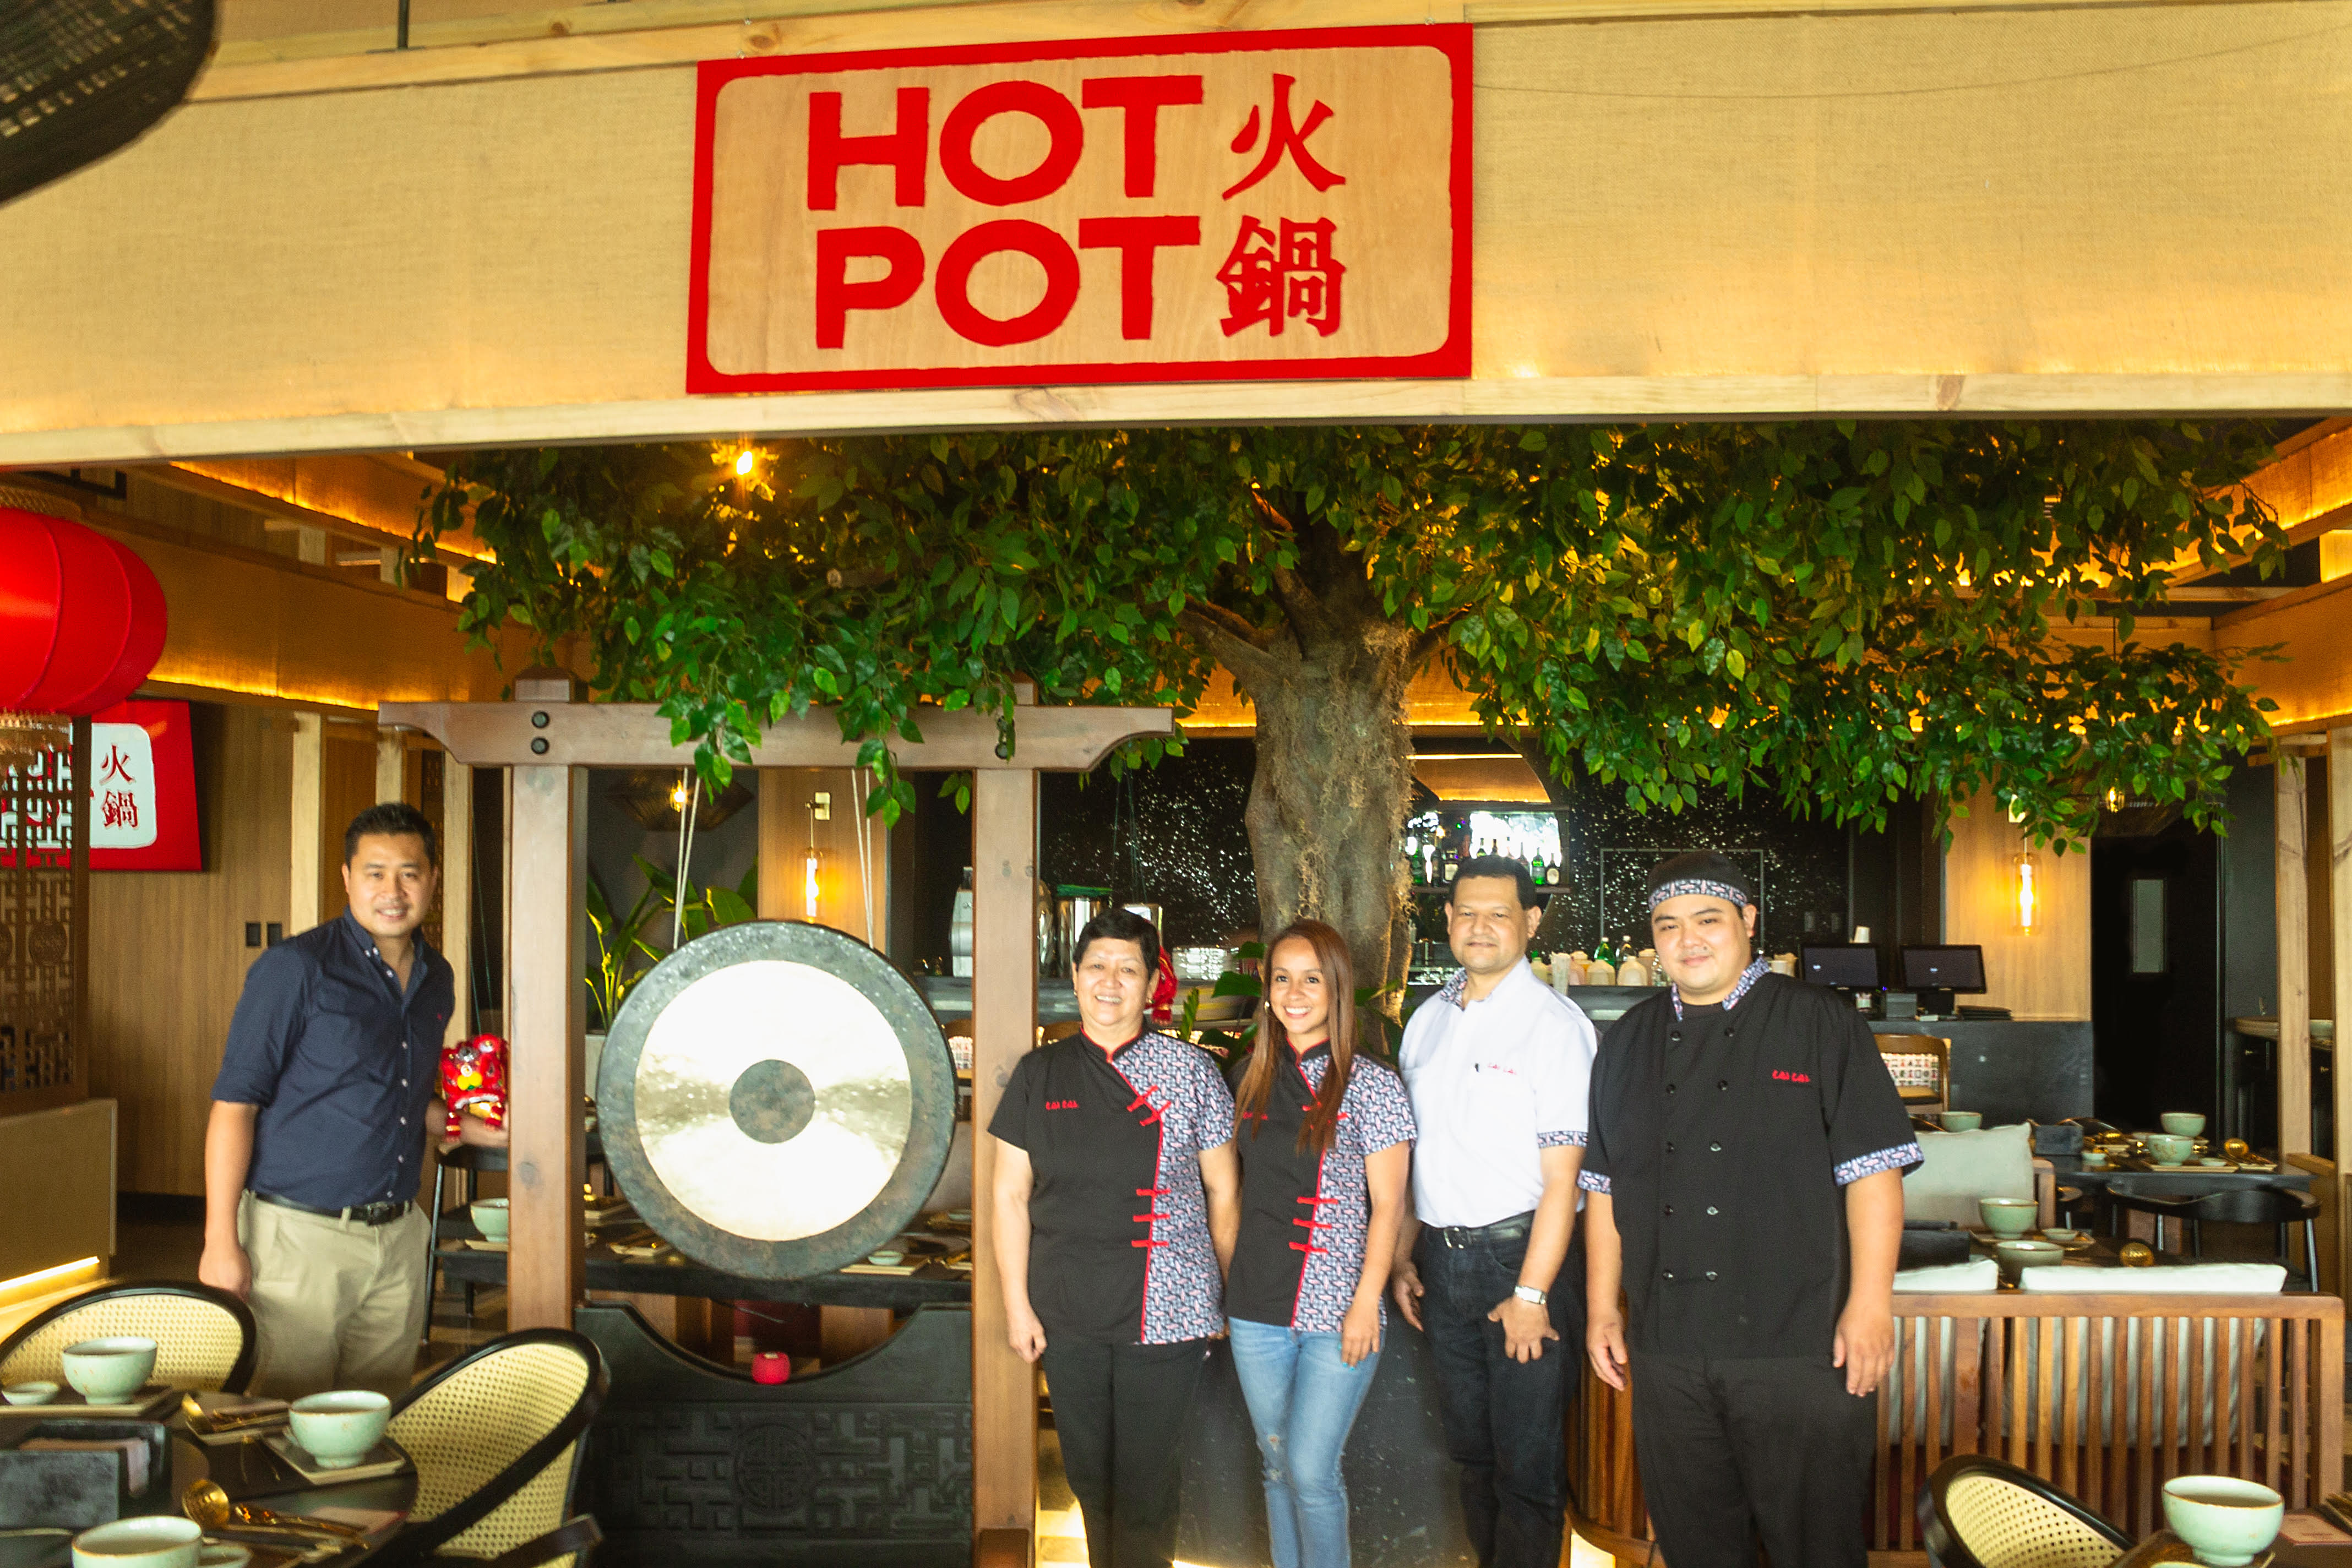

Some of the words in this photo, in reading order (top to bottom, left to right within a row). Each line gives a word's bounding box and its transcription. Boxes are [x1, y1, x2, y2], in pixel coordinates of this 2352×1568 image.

[807, 75, 1204, 210] HOT
[1216, 73, 1347, 337] 火鍋
[816, 215, 1201, 349] POT
[100, 744, 138, 828] 火鍋
